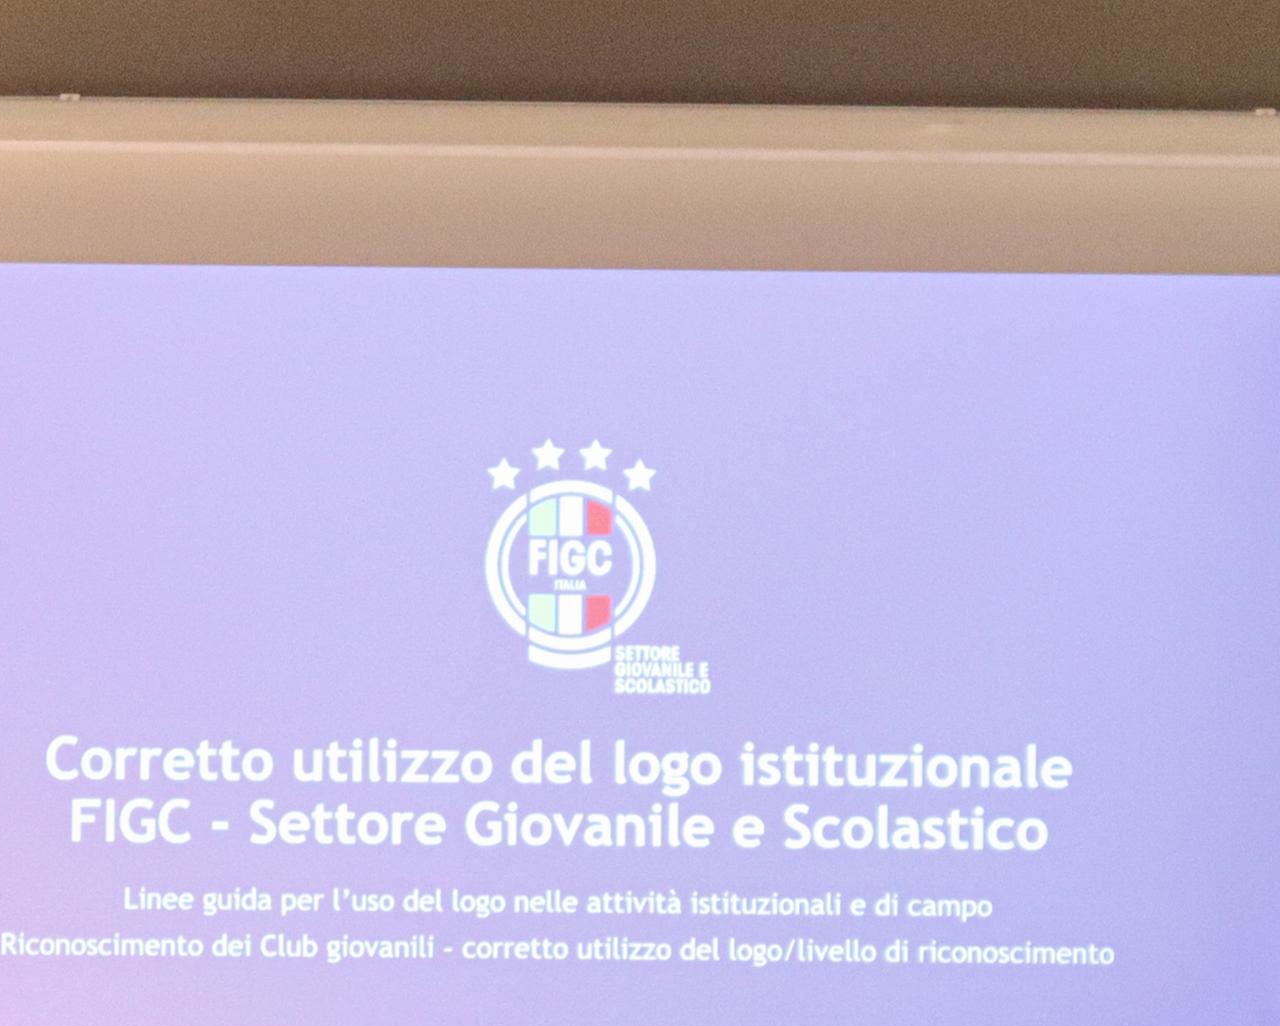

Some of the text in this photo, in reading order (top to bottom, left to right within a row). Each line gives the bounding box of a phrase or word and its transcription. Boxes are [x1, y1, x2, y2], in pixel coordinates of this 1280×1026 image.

[529, 538, 613, 576] FIGC
[553, 579, 588, 591] ITALIA
[614, 661, 710, 678] GIOVANILE E
[615, 645, 680, 661] SETTORE
[614, 678, 711, 695] SCOLASTICO
[46, 735, 1073, 797] Corretto utilizzo del logo istituzionale
[71, 797, 191, 844] FIGC
[249, 798, 447, 845] Settore
[465, 801, 714, 848] Giovanile
[732, 815, 765, 848] e
[783, 803, 1048, 851] Scolastico
[124, 886, 194, 910] Linee
[203, 887, 272, 916] guida
[281, 893, 324, 916] per
[403, 888, 443, 912] del
[452, 889, 506, 918] logo
[514, 889, 578, 914] nelle
[586, 889, 681, 914] attività
[690, 891, 841, 916] istituzionali
[849, 898, 866, 916] e
[874, 892, 898, 916] di
[906, 898, 992, 923] campo
[1, 932, 204, 956] Riconoscimento
[212, 933, 251, 957] dei
[260, 933, 318, 958] Club
[326, 934, 434, 963] giovanili
[462, 938, 569, 960] corretto
[577, 936, 672, 961] utilizzo
[679, 937, 720, 961] del
[728, 937, 877, 968] logo/livello
[884, 939, 908, 963] di
[918, 939, 1115, 966] riconoscimento
